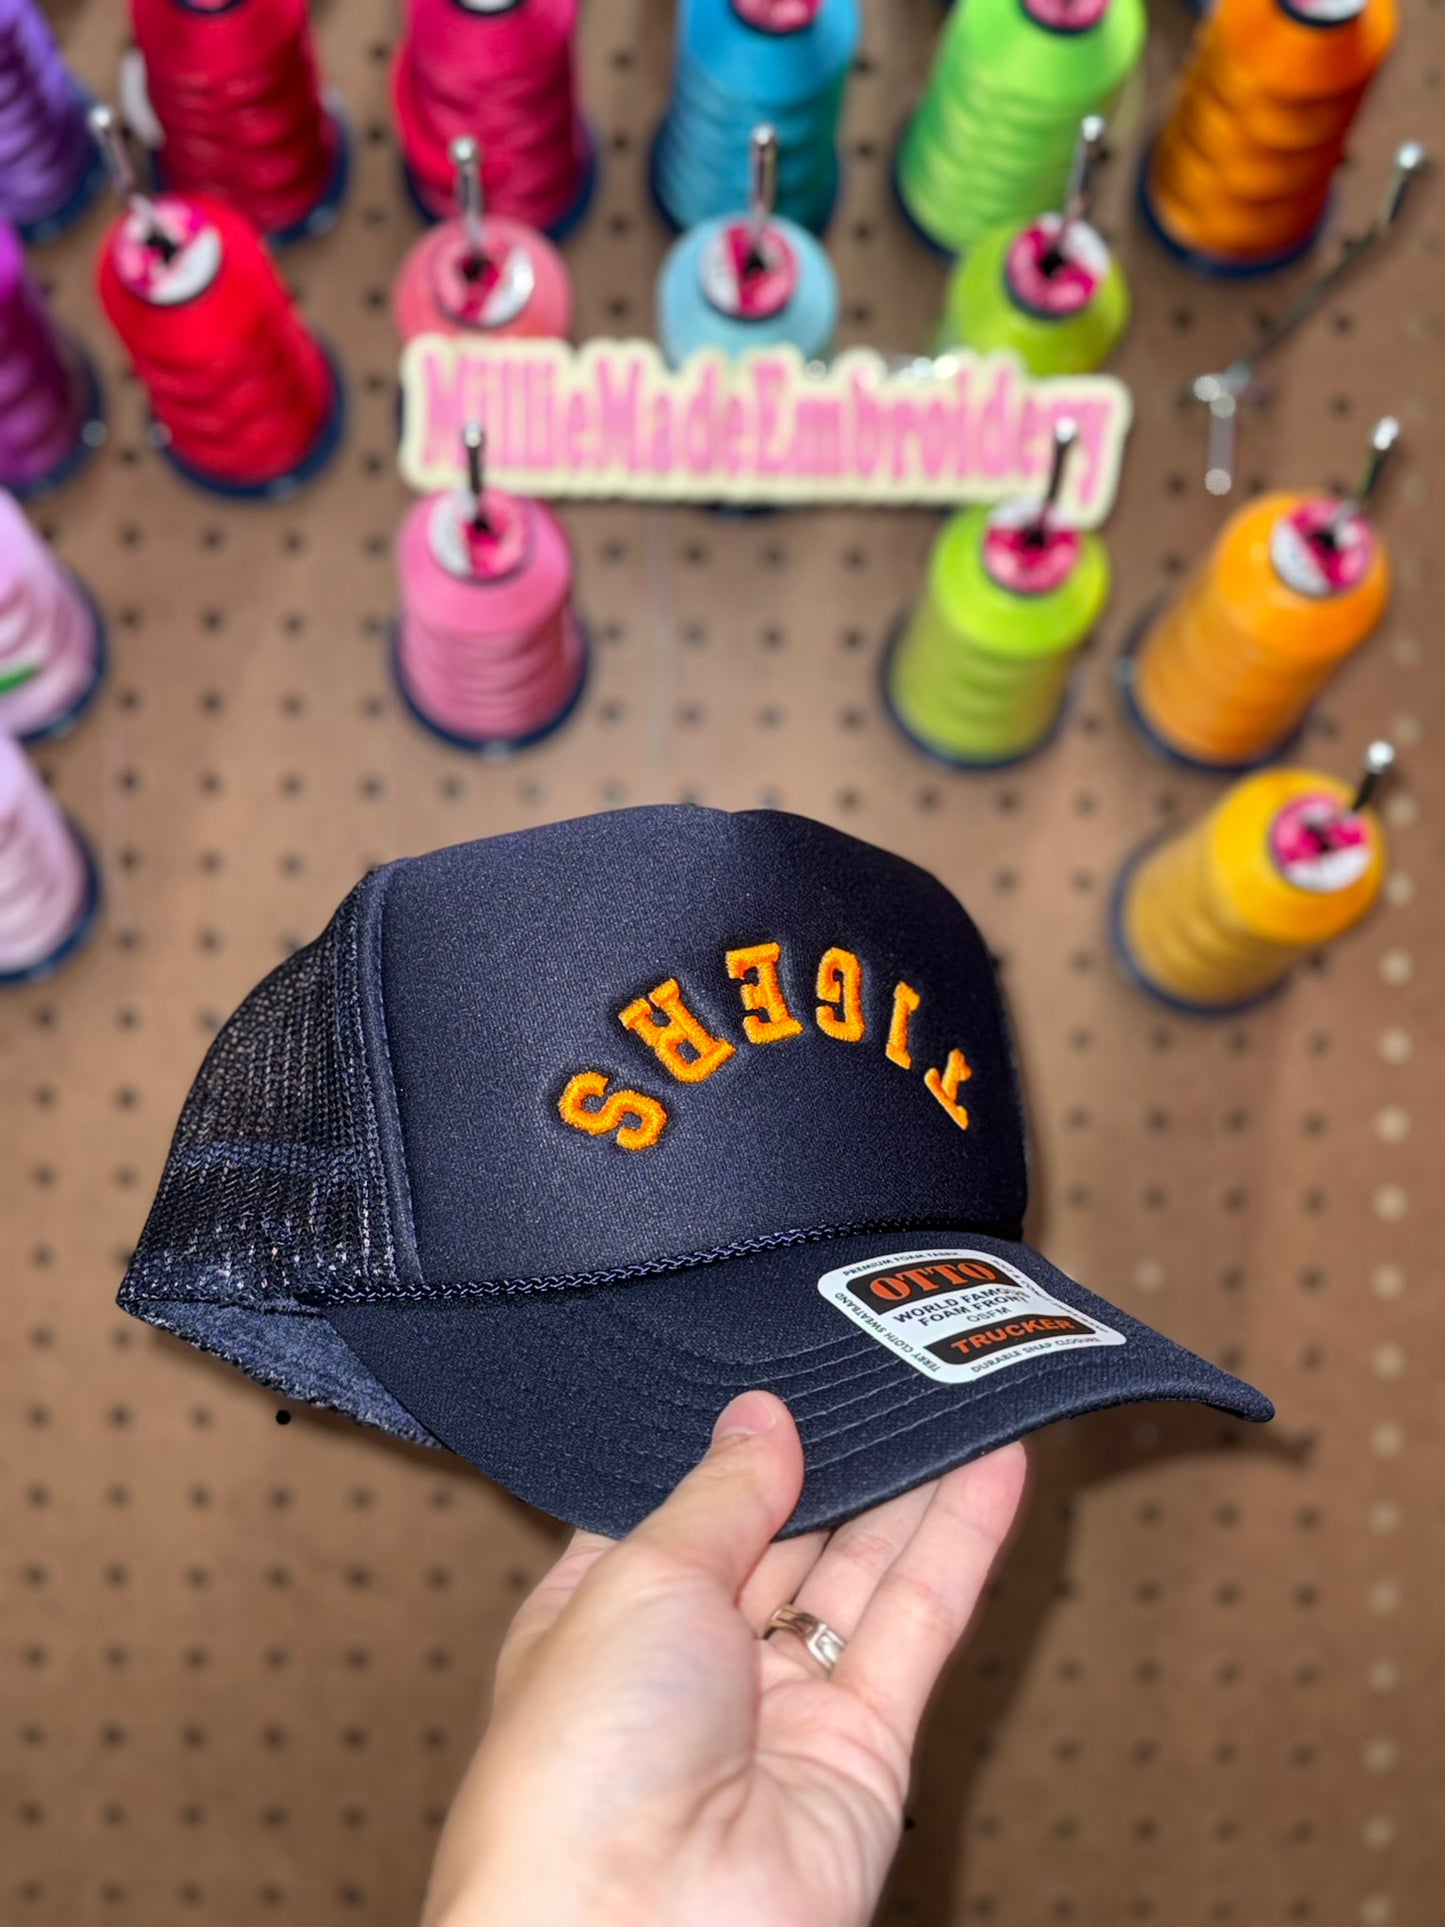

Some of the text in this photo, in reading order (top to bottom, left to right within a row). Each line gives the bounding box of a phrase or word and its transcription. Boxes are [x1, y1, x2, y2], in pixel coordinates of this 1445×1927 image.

[560, 943, 971, 1150] TIGERS
[843, 1258, 893, 1276] PREMIUM
[870, 1262, 997, 1300] OTTO
[892, 1298, 959, 1323] WORLD
[918, 1305, 971, 1326] FOAM
[966, 1306, 1012, 1322] OSFM
[834, 1291, 941, 1374] TERRY CLOTH SWEATBAND
[951, 1318, 1077, 1354] TRUCKER
[971, 1350, 1021, 1374] DURABLE
[1024, 1341, 1052, 1354] SNAP
